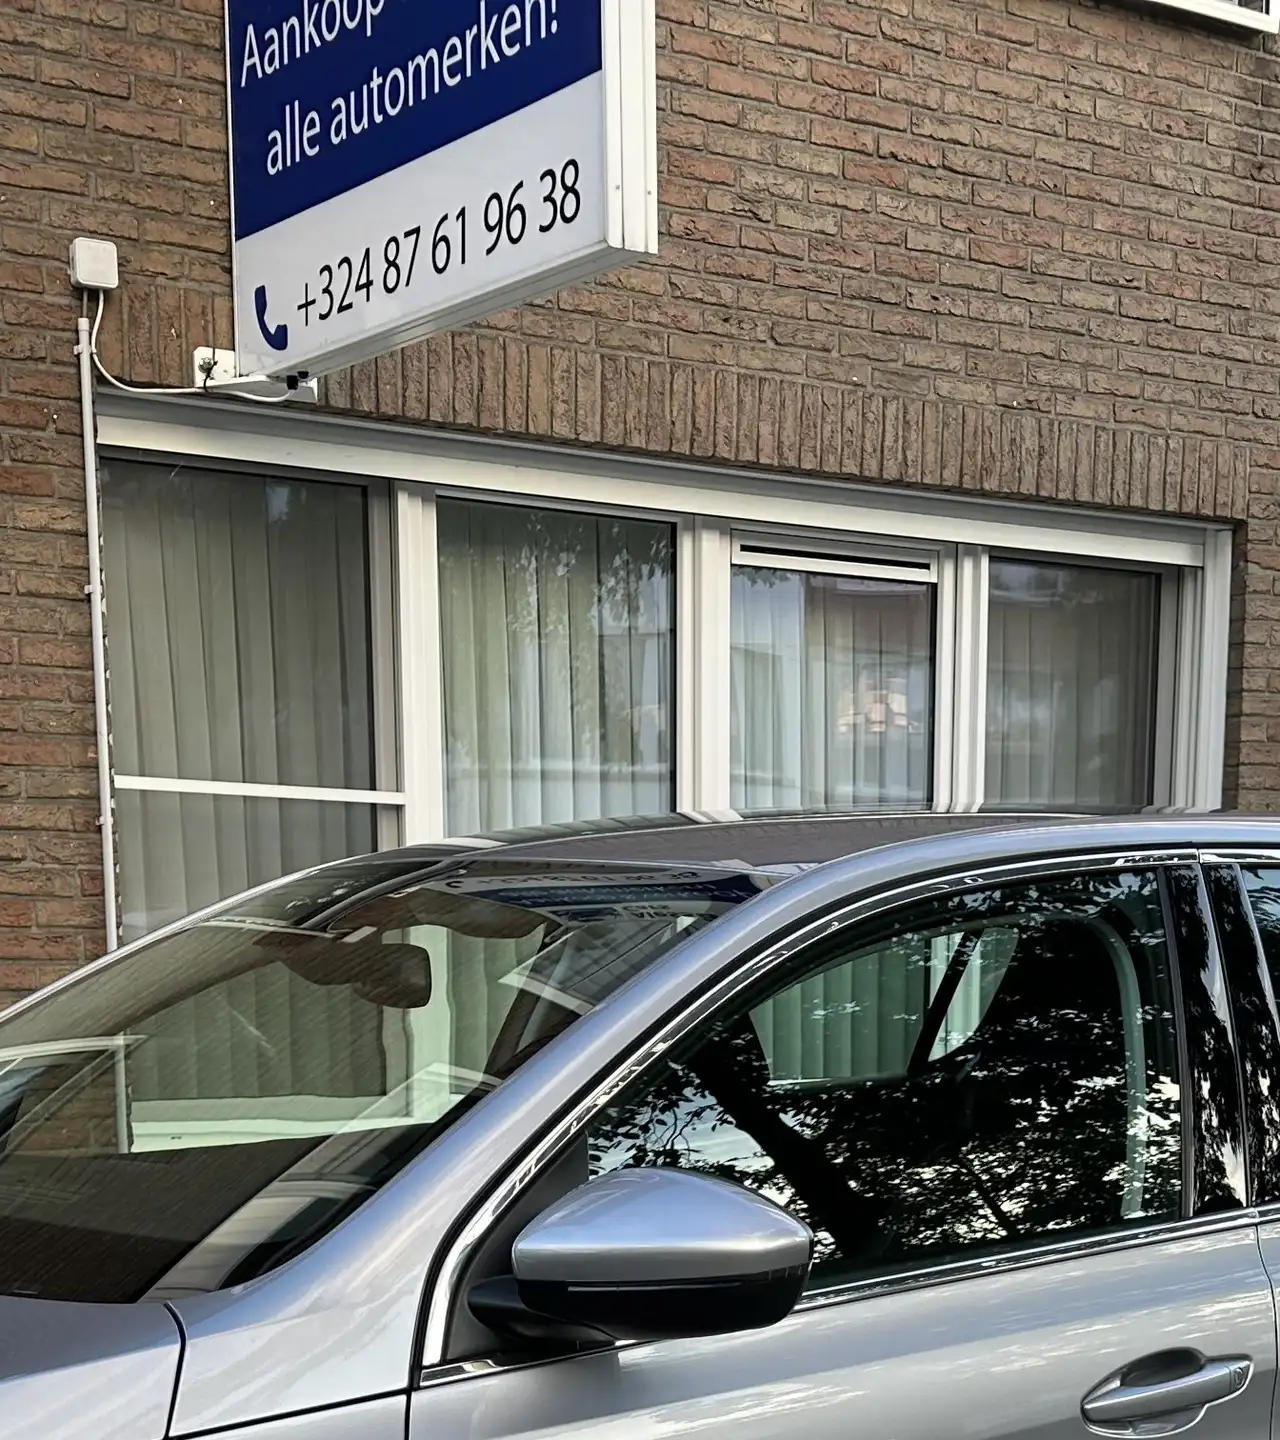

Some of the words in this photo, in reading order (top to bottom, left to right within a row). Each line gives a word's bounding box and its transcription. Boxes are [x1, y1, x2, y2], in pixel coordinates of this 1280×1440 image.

[240, 0, 385, 88] Aankoop
[266, 99, 321, 176] alle
[330, 0, 558, 145] automerken!
[297, 247, 374, 327] +324
[382, 225, 421, 294] 87
[431, 206, 468, 275] 61
[483, 180, 527, 256] 96
[538, 158, 581, 233] 38
